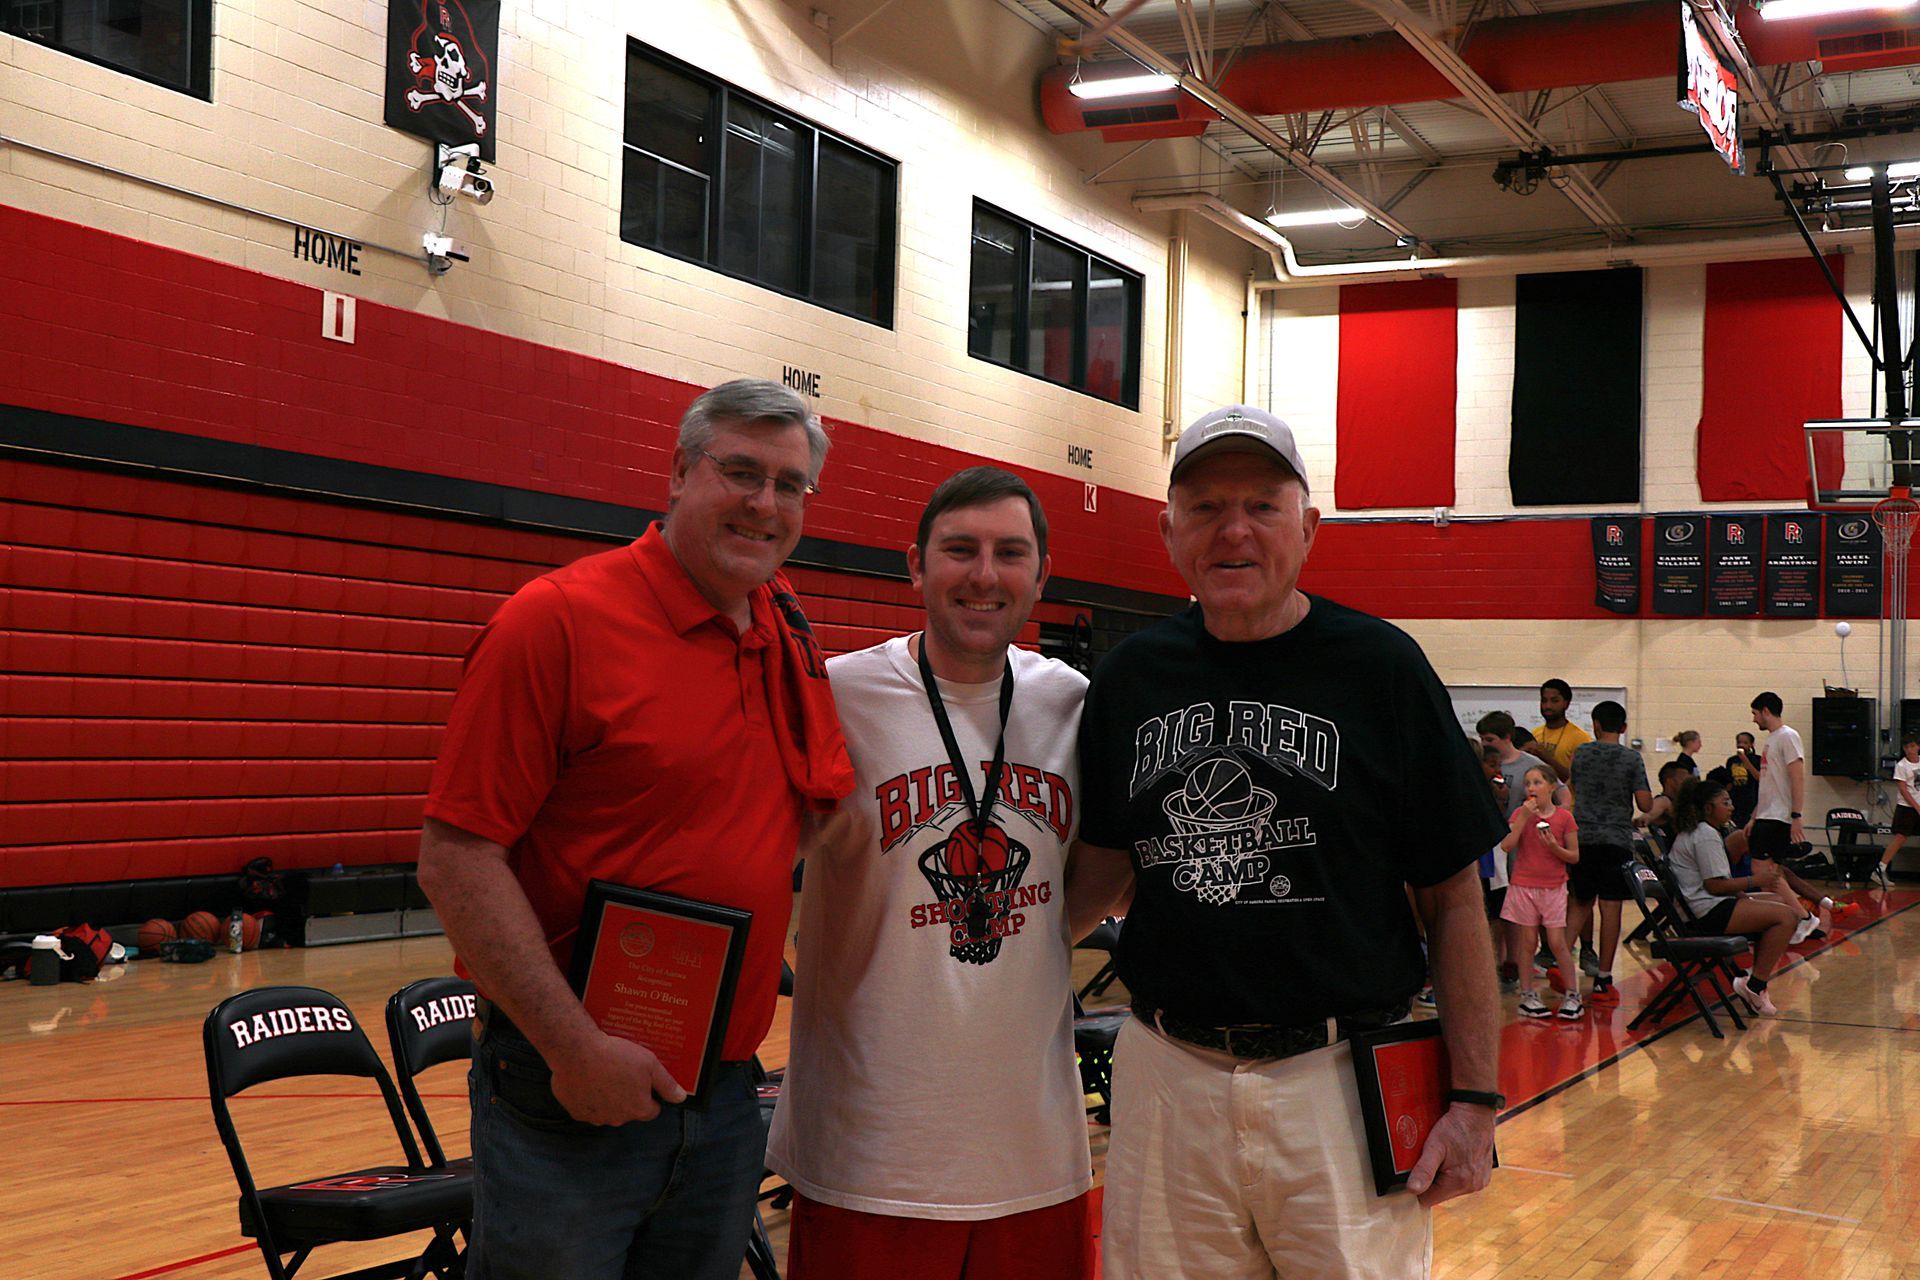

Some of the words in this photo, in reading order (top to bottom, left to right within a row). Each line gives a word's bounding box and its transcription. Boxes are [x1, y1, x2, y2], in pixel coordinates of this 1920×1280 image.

[294, 226, 361, 276] HOME
[783, 365, 820, 398] HOME
[1068, 444, 1093, 469] HOME
[1086, 485, 1095, 510] K
[1129, 701, 1215, 803] BIG
[1226, 700, 1340, 792] RED
[876, 763, 963, 855] BIG
[980, 761, 1073, 845] RED
[1134, 817, 1317, 869] BASKETBALL
[1172, 854, 1271, 892] CAMP
[950, 914, 1026, 946] CMP
[410, 993, 477, 1033] RAIDE
[614, 982, 647, 999] Shawn
[650, 990, 689, 1007] O'Brien
[229, 1004, 355, 1050] RAIDERS
